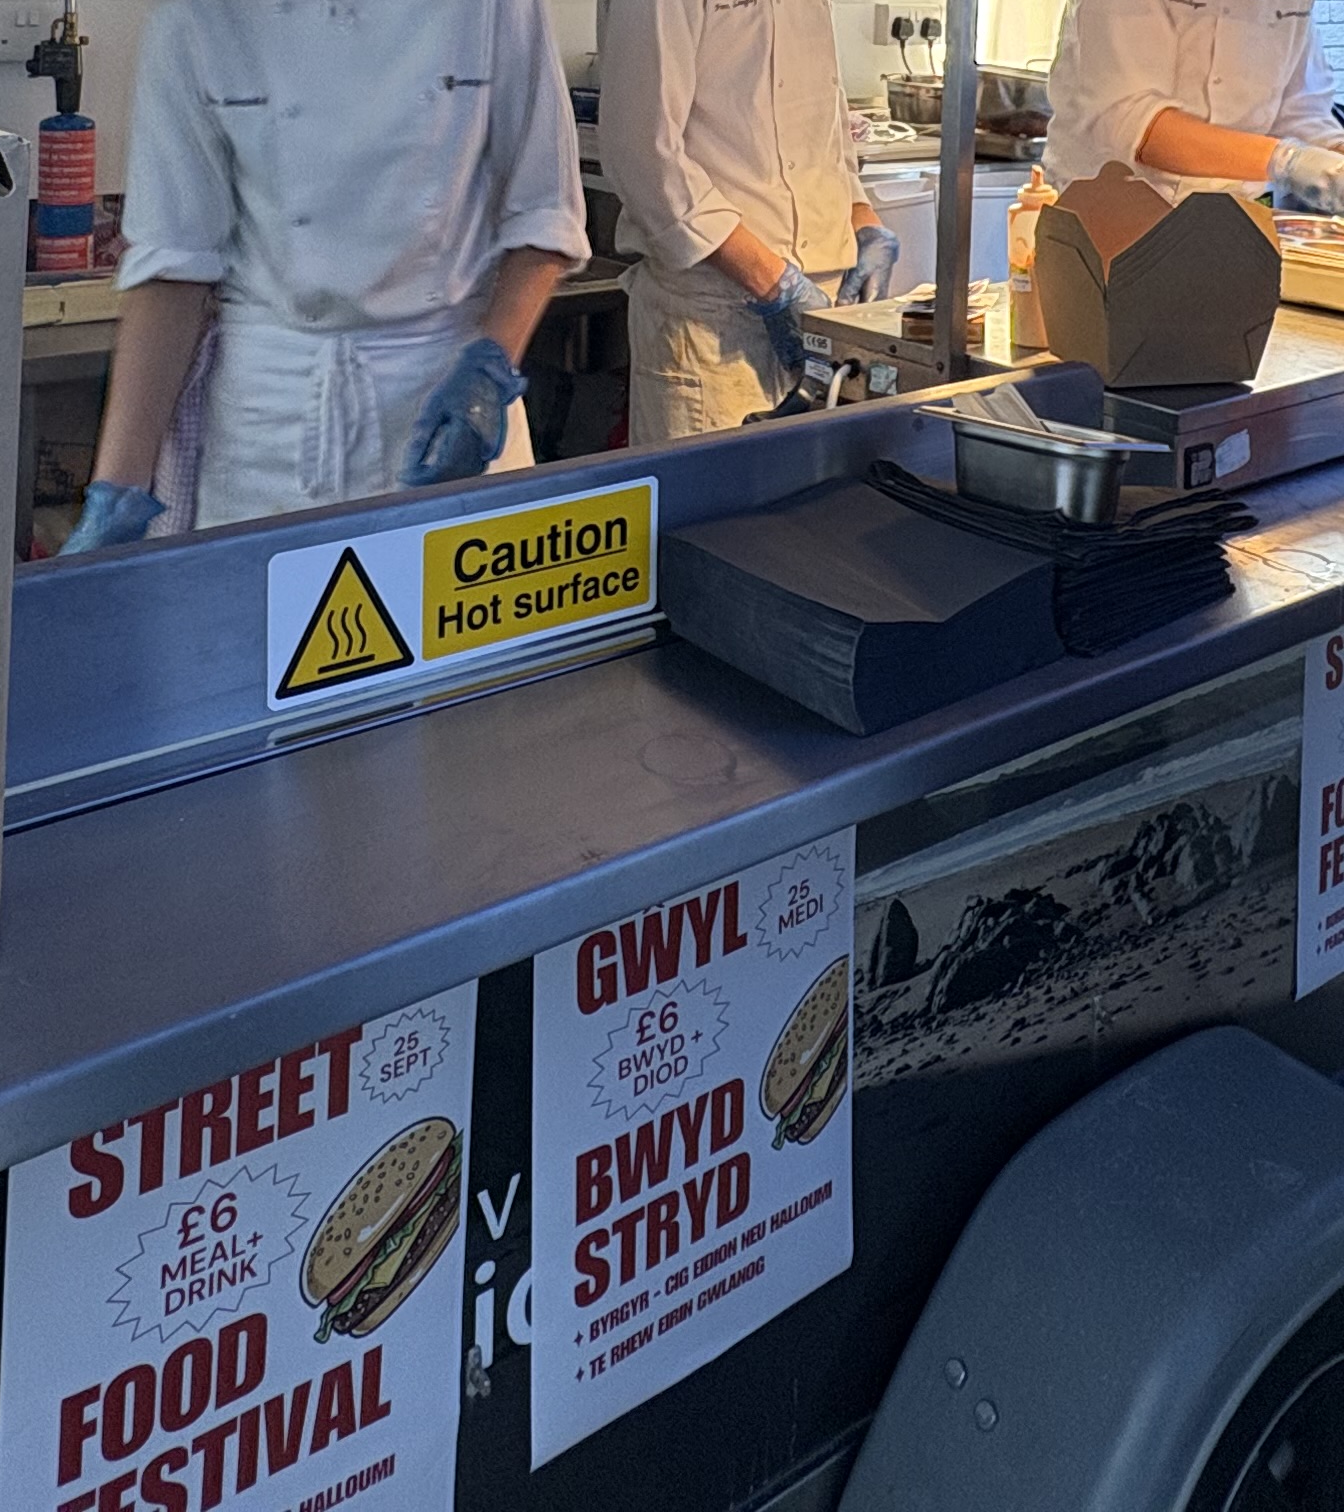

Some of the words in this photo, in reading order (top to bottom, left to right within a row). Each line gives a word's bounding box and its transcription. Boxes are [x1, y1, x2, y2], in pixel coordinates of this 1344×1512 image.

[454, 516, 628, 583] Caution
[438, 594, 502, 639] Hot
[514, 566, 640, 619] surface
[778, 895, 824, 934] MEDI
[788, 879, 810, 908] 25
[393, 1031, 419, 1057] 25
[636, 1001, 679, 1046] £6
[380, 1046, 431, 1083] SEPT
[618, 1034, 685, 1081] BWYD
[634, 1055, 689, 1097] DIOD
[68, 1025, 362, 1218] STREET
[575, 1078, 745, 1227] BWYD
[178, 1192, 238, 1250] £6
[573, 1152, 751, 1308] STRYD
[164, 1254, 258, 1317] DRINK
[589, 1290, 649, 1343] BYRGYR
[665, 1267, 689, 1296] CIG
[693, 1237, 737, 1280] EIDION
[741, 1220, 766, 1252] NEU
[770, 1180, 833, 1233] HALLOUMI
[589, 1350, 607, 1380] TE
[610, 1321, 654, 1367] RHEW
[658, 1299, 693, 1336] EIRIN
[697, 1256, 765, 1311] GWLANOG
[56, 1344, 391, 1512] STIVAL
[57, 1312, 267, 1487] FOOD
